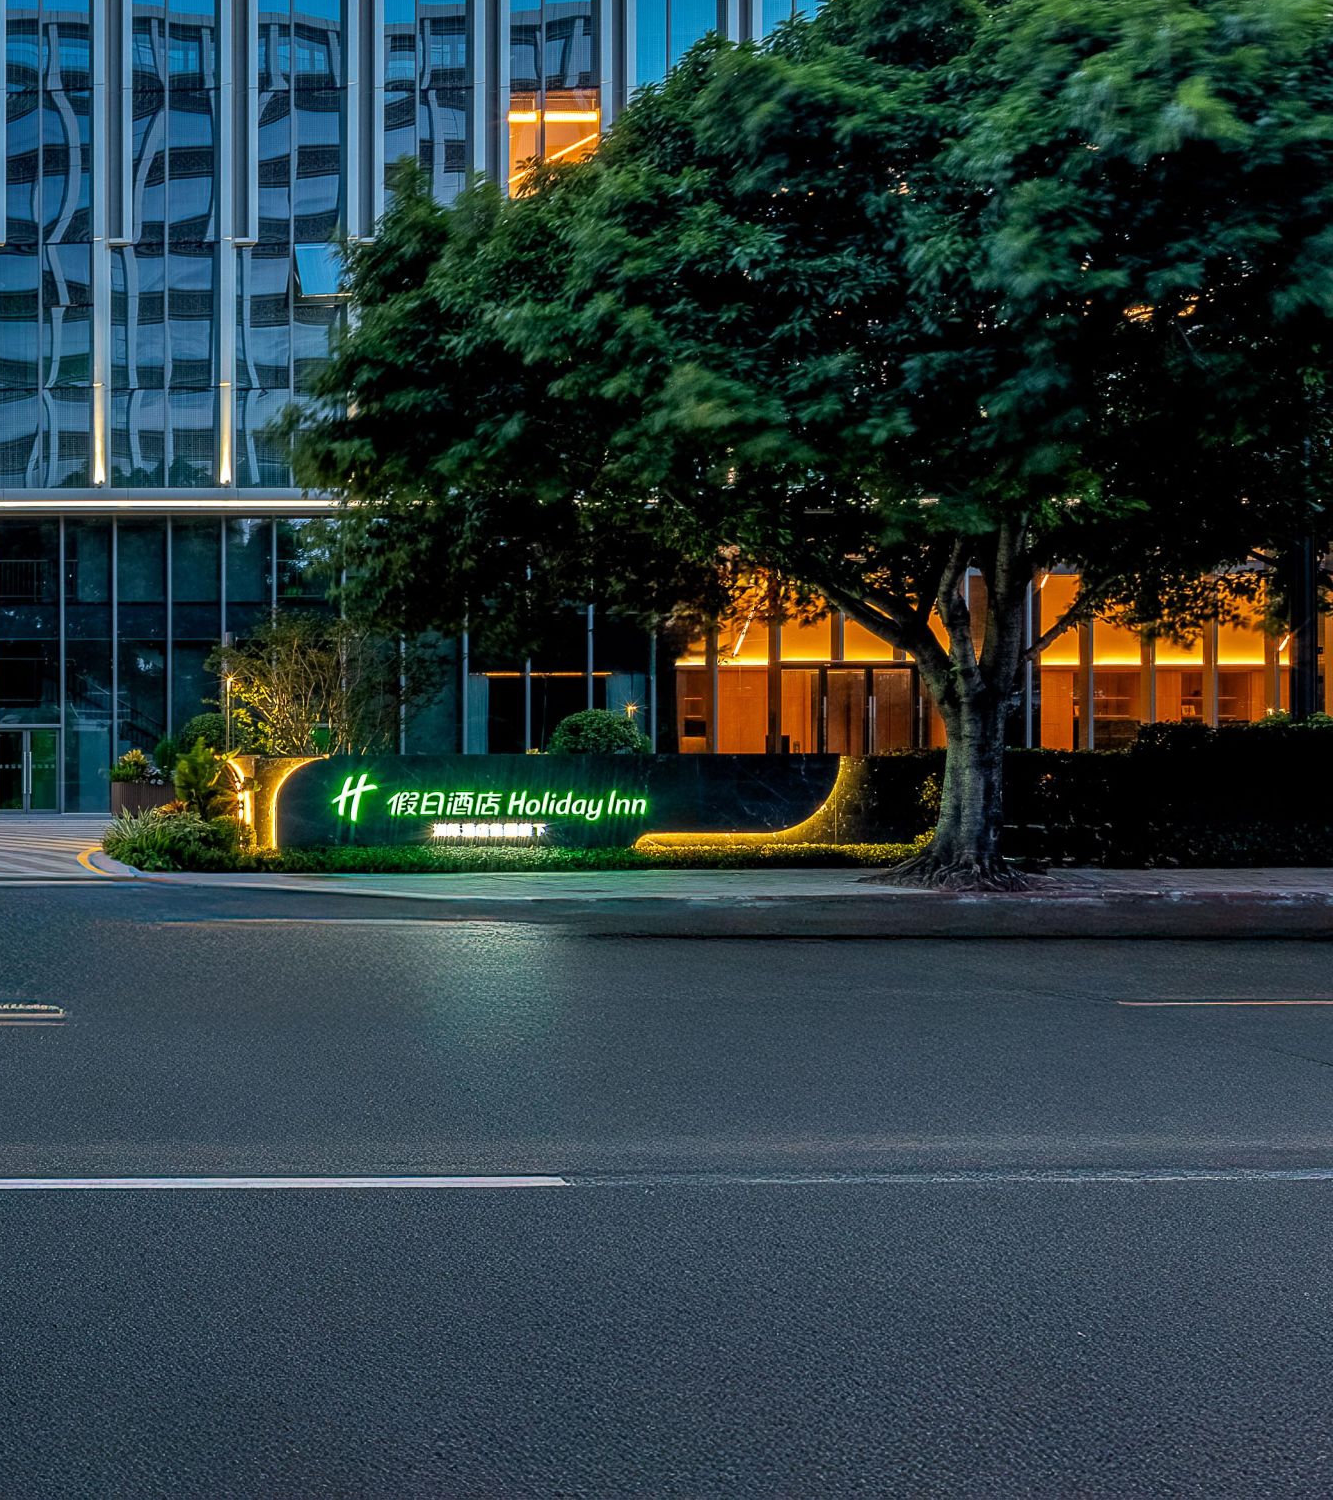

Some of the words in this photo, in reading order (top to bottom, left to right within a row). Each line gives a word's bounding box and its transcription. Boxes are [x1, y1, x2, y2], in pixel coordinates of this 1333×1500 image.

[387, 791, 502, 816] 假日酒店
[507, 791, 602, 821] Holiday
[607, 790, 647, 815] Inn
